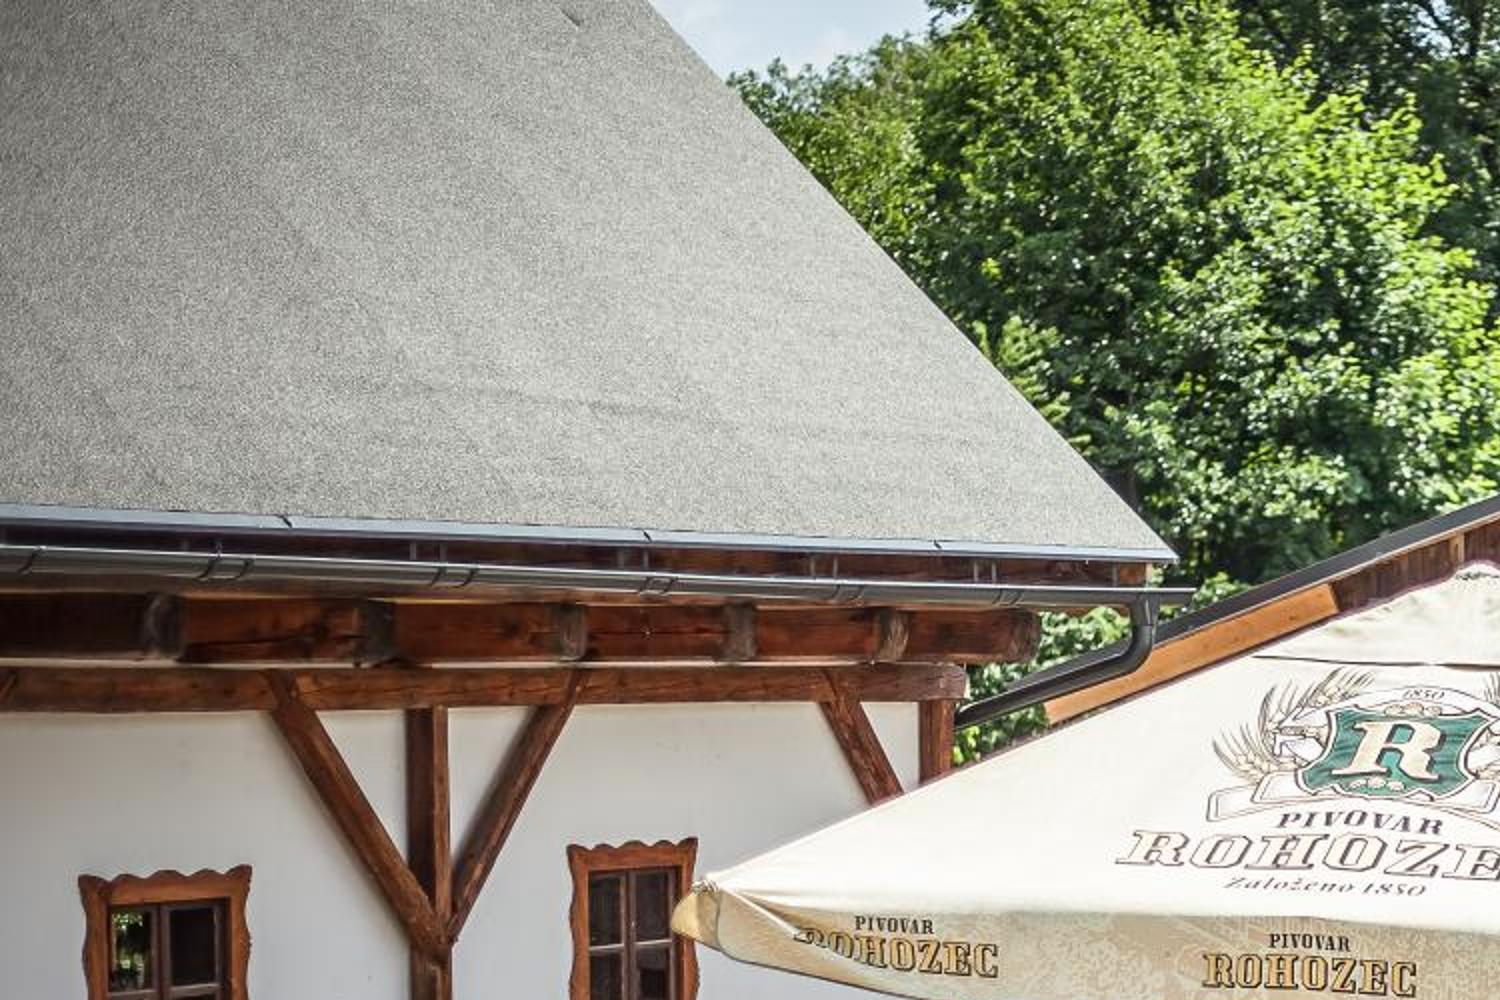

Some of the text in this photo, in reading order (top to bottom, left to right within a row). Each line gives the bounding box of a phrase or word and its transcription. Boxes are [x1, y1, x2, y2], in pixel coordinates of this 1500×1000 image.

[1331, 719, 1446, 783] R
[1276, 809, 1443, 835] PIVOVAR
[1362, 883, 1427, 897] 1850
[855, 915, 934, 934] PIVOVAR
[1269, 933, 1351, 951] PIVOVAR
[1202, 953, 1417, 998] ROHOZEC
